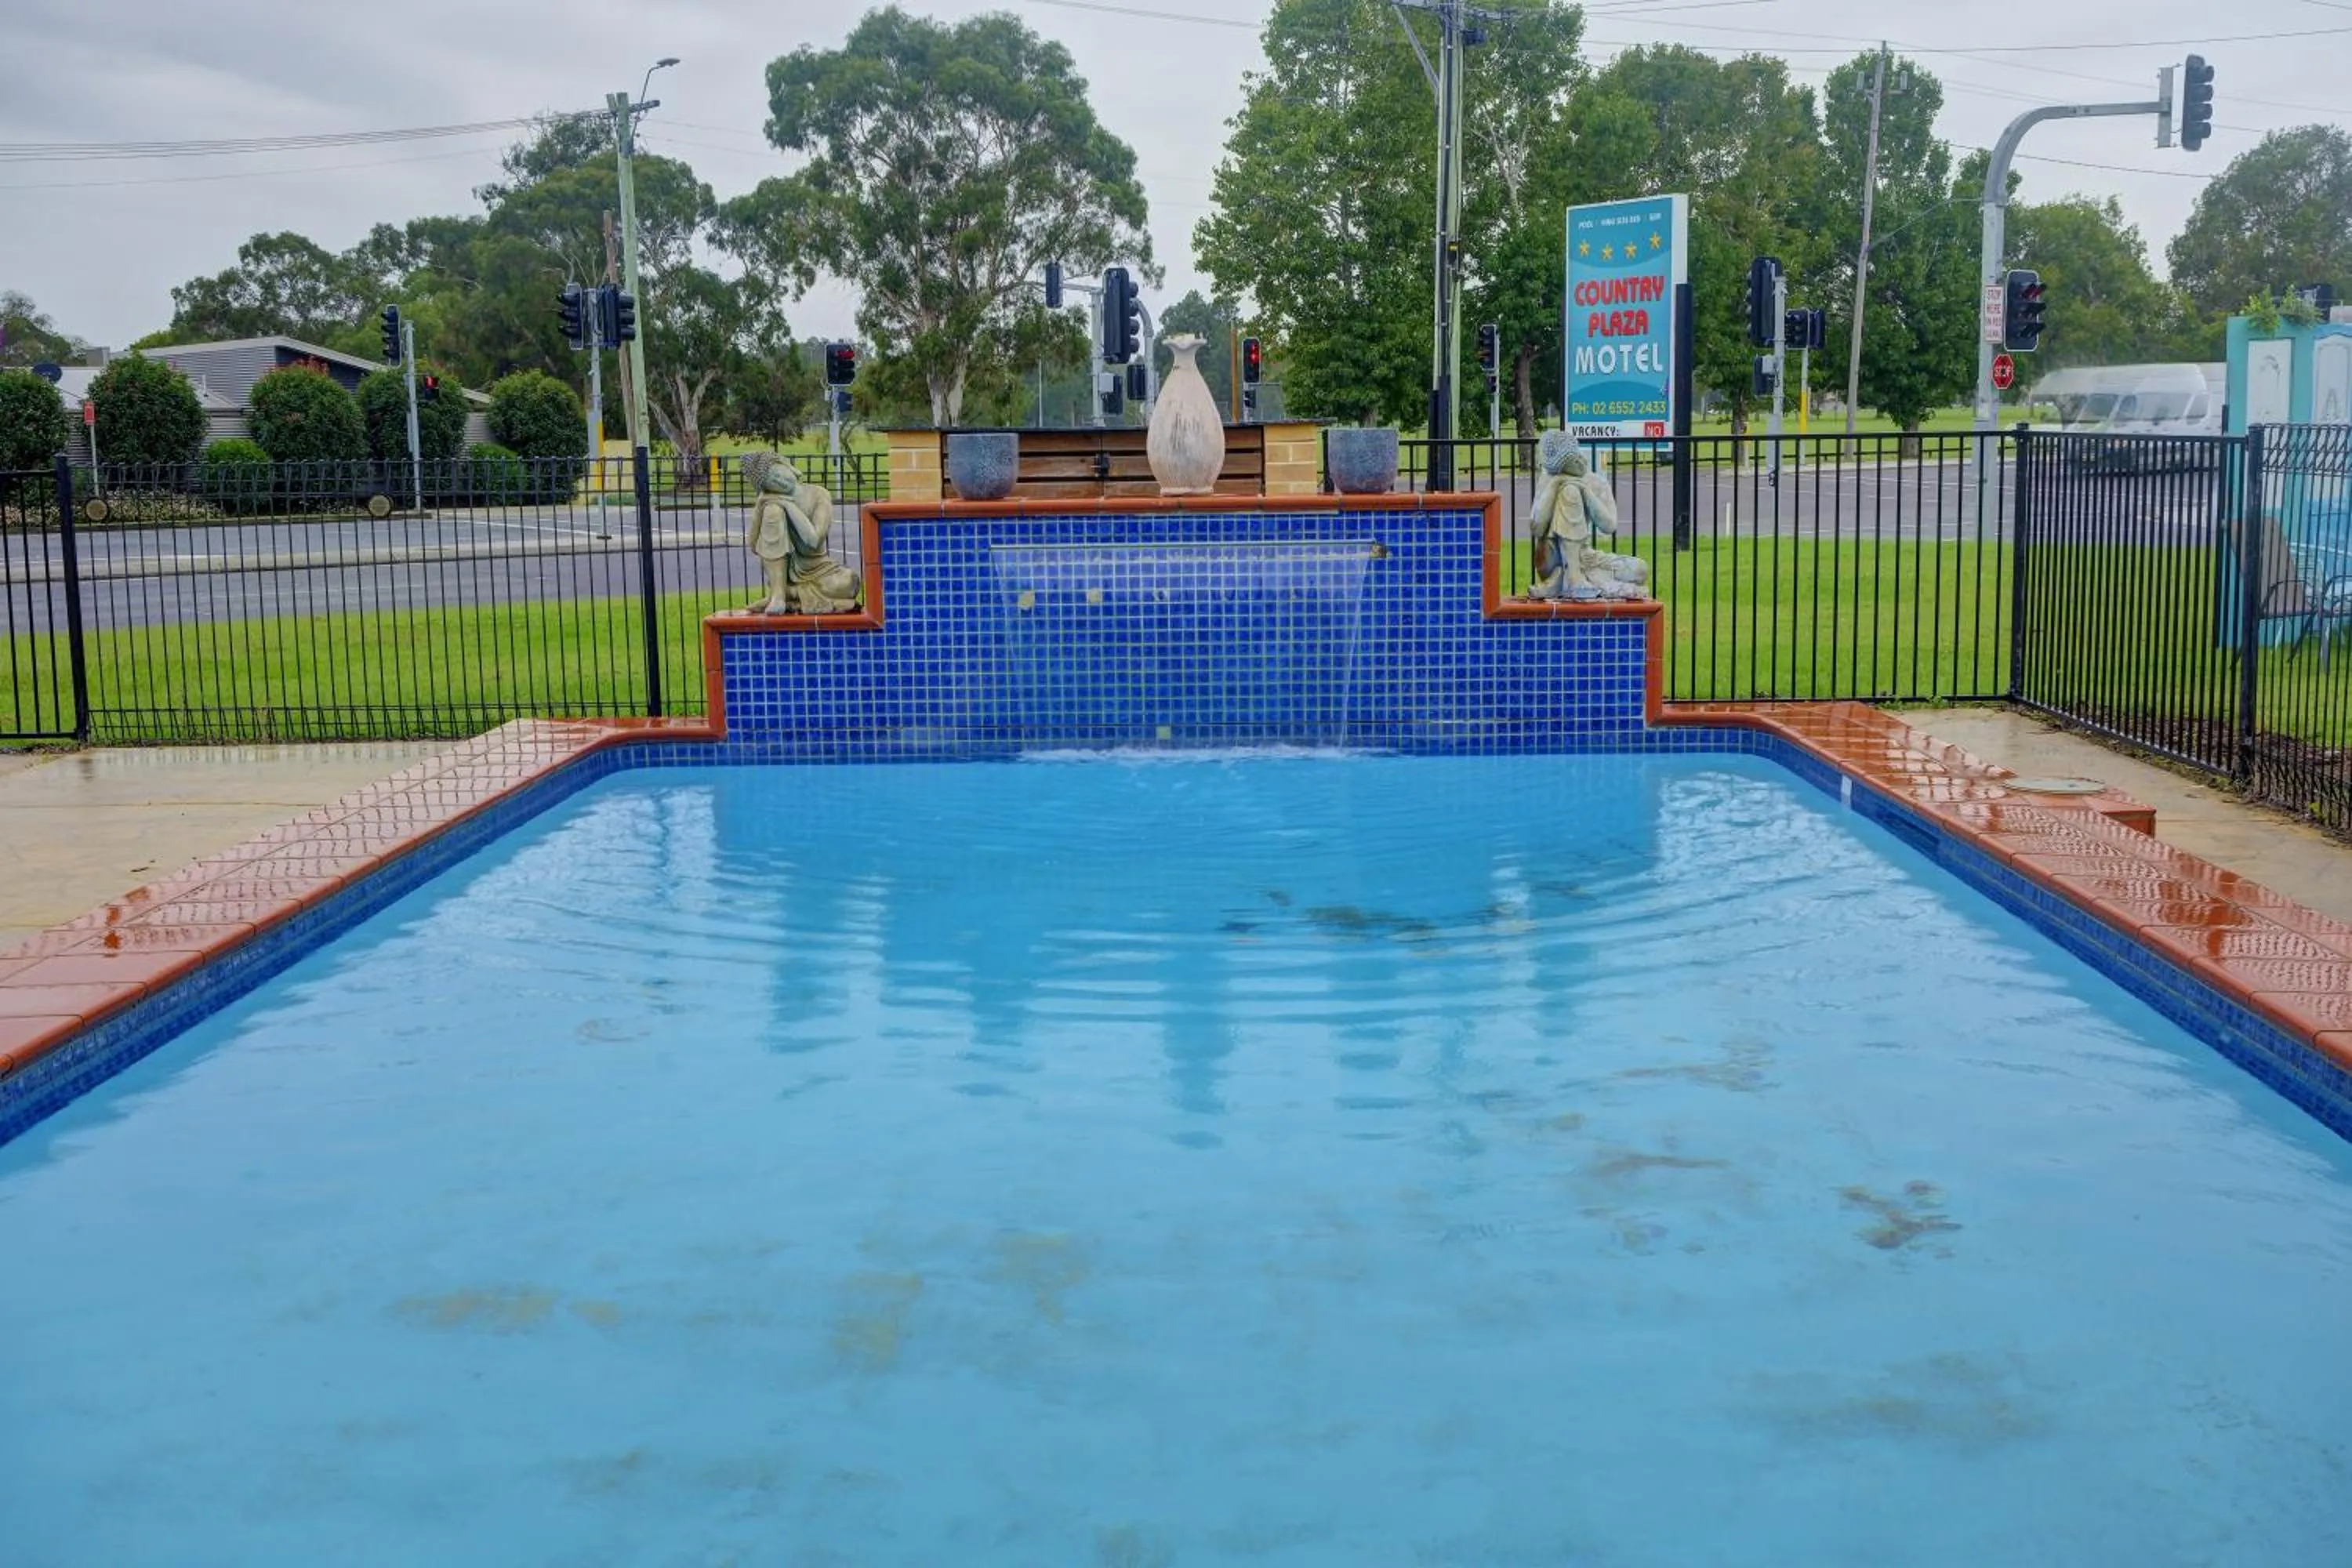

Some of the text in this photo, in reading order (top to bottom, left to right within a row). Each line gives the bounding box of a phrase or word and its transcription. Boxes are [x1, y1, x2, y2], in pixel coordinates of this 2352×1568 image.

[1574, 275, 1664, 306] COUNTRY
[1588, 308, 1650, 338] PLAZA
[1574, 342, 1664, 376] MOTEL
[1571, 401, 1666, 415] PH: 02 6552 2433
[1571, 426, 1620, 437] VACANCY:
